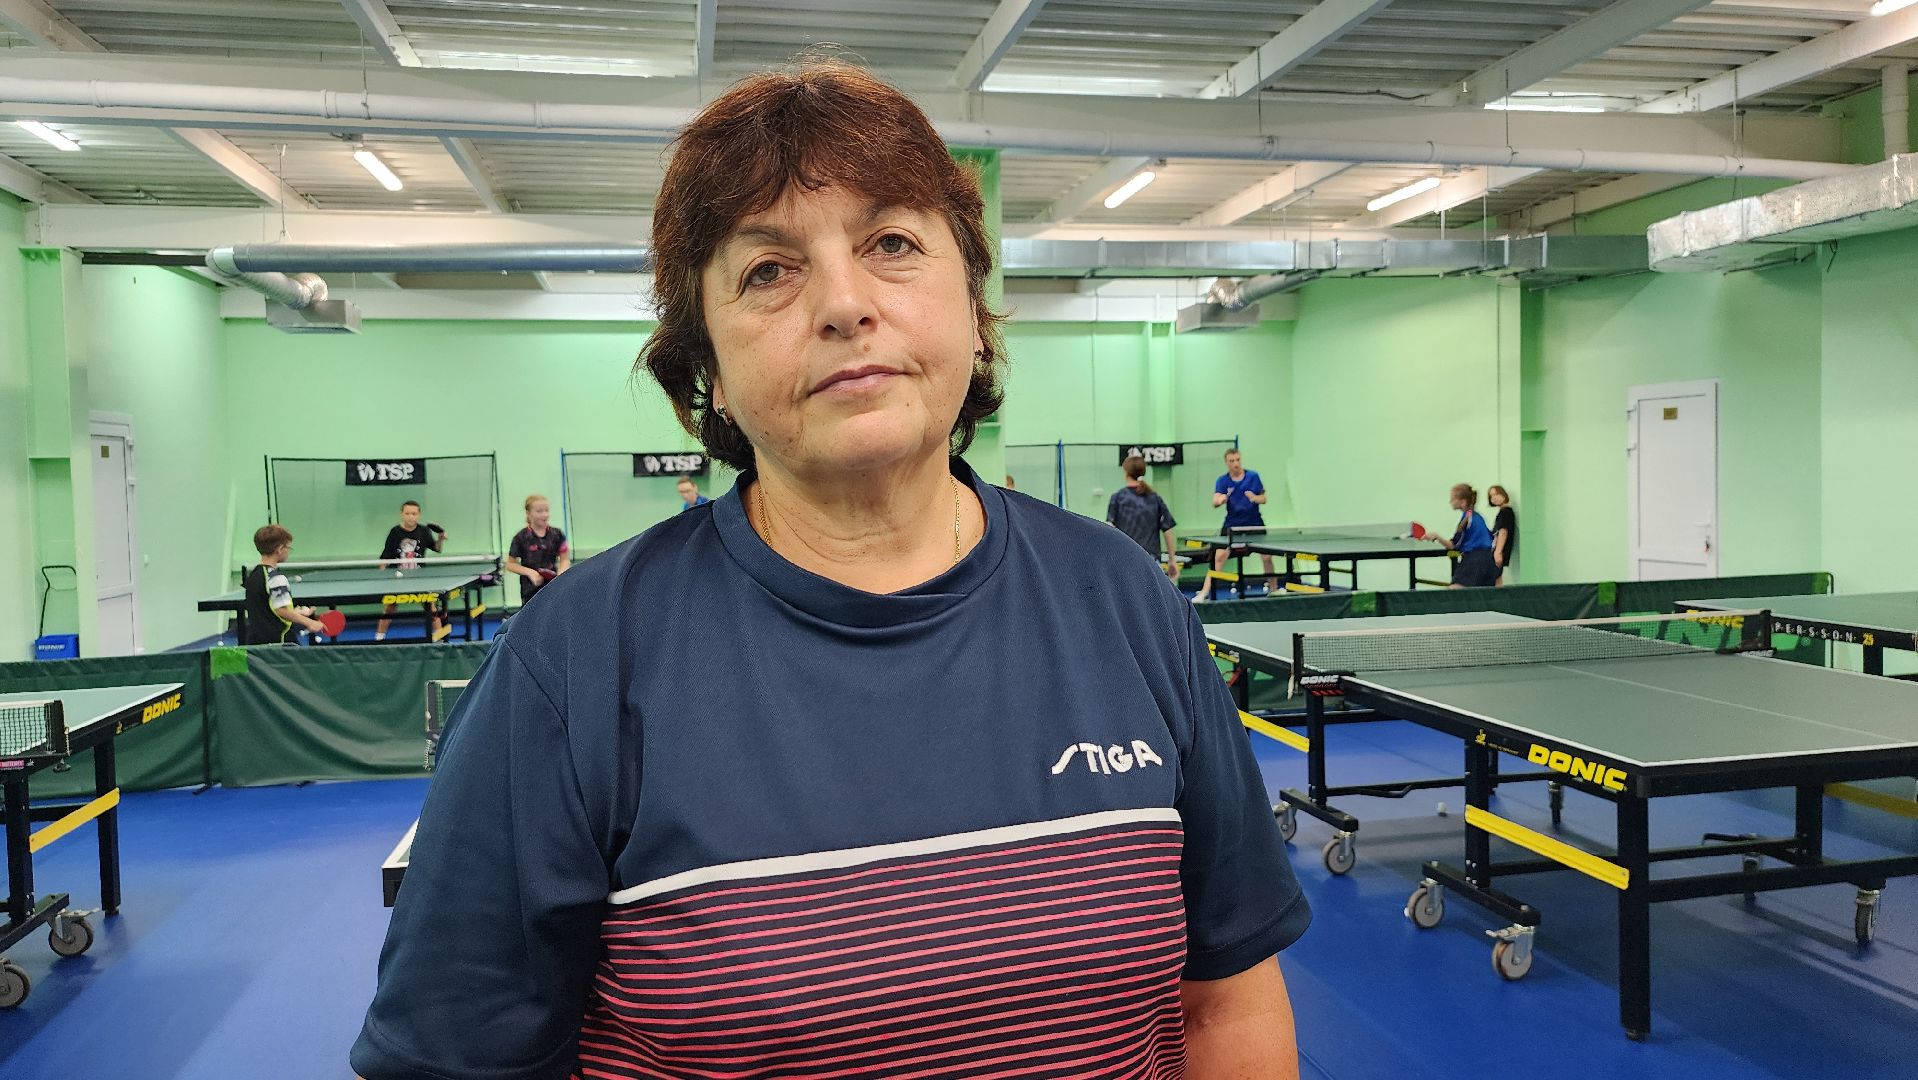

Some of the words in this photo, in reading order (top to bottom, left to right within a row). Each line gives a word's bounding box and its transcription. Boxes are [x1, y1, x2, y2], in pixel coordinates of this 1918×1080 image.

[1142, 447, 1175, 462] TSP
[376, 463, 414, 480] TSP
[660, 455, 702, 472] TSP
[382, 593, 439, 604] DONIC
[1300, 675, 1339, 684] DONIC
[142, 693, 181, 724] DONIC
[1051, 740, 1163, 775] STIGA
[1527, 743, 1628, 792] DONIC
